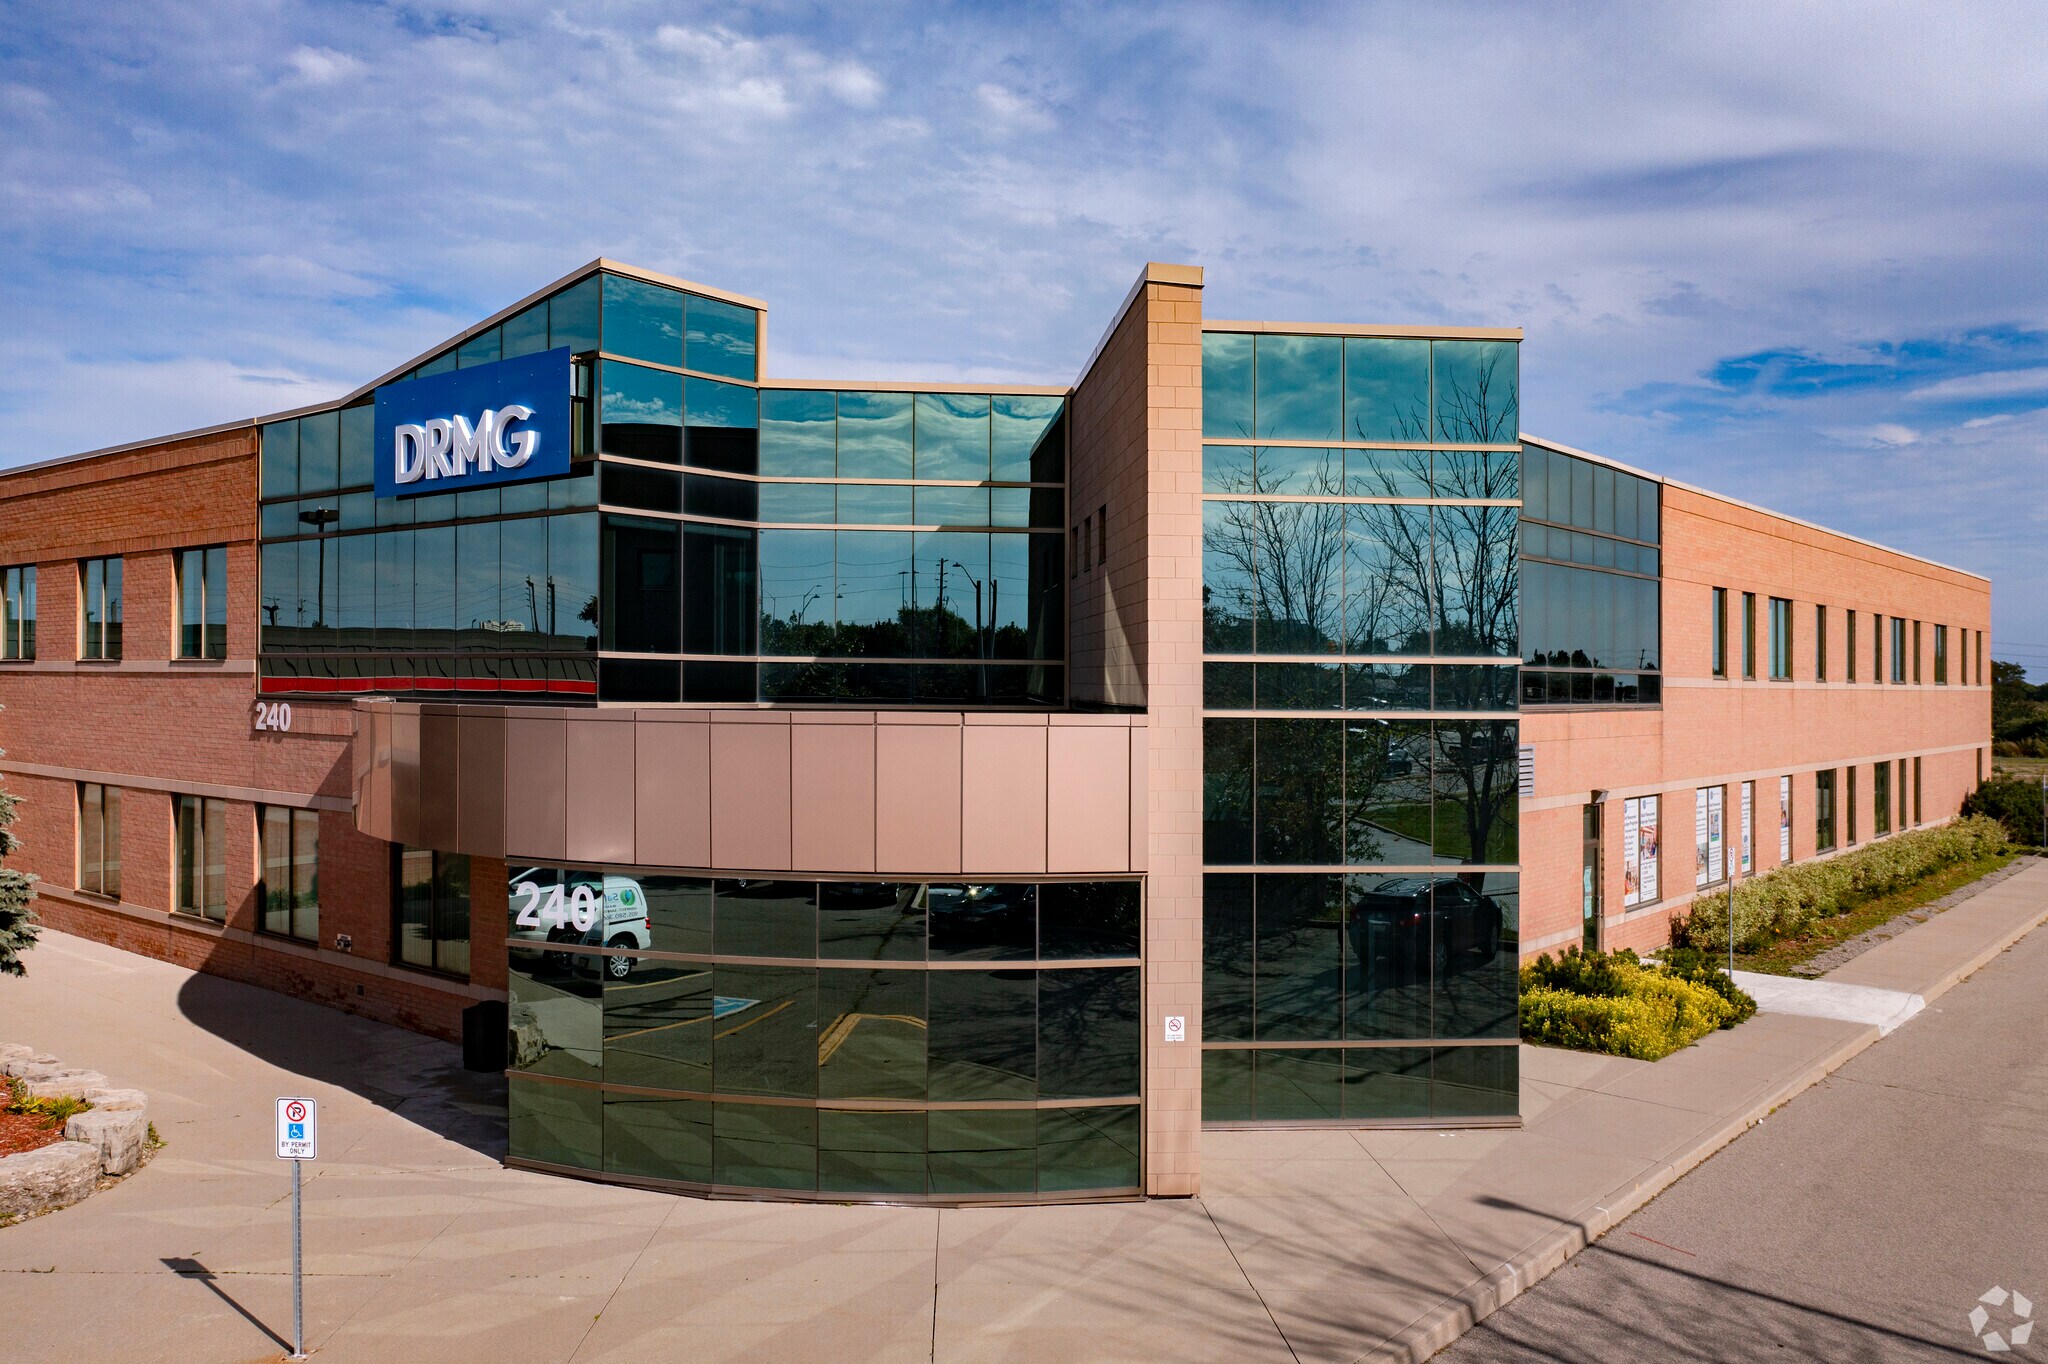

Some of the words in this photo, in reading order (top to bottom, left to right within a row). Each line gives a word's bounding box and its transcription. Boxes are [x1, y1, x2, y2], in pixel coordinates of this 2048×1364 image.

[395, 404, 539, 484] DRMG
[255, 702, 292, 732] 240
[516, 881, 595, 931] 240
